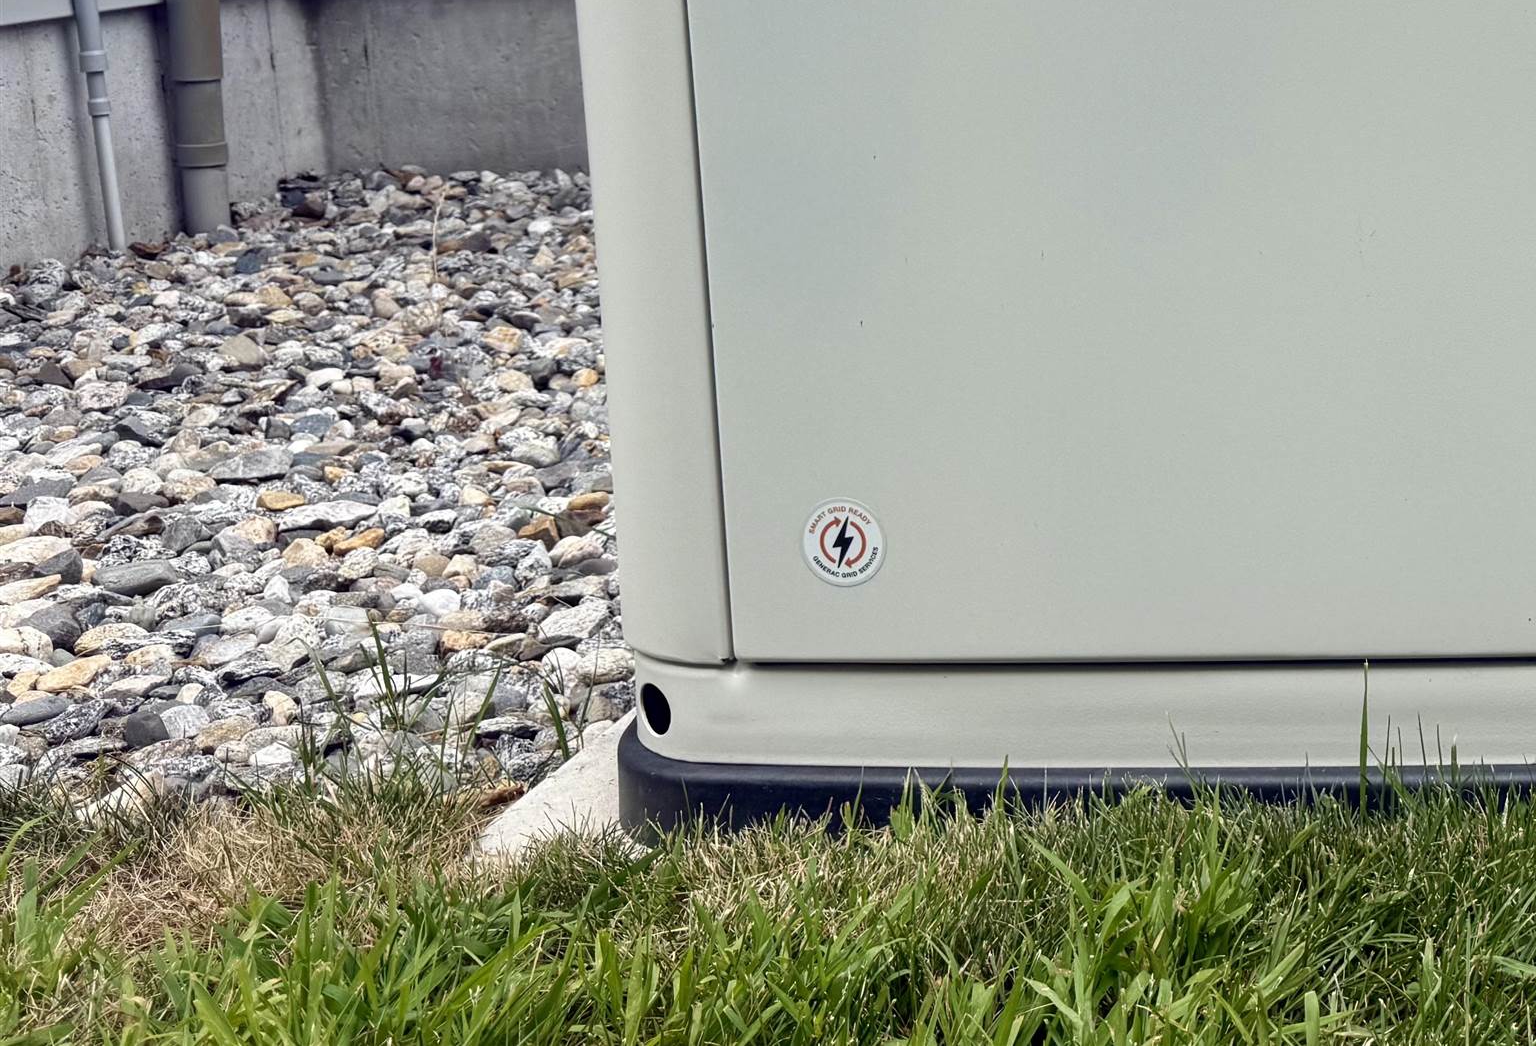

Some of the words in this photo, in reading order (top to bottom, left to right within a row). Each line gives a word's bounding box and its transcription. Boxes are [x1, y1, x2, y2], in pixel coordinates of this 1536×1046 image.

[808, 511, 826, 535] SMART
[827, 505, 847, 514] GRID
[848, 507, 872, 525] READY
[812, 555, 840, 578] GENERAC
[841, 570, 858, 579] GRID
[858, 546, 879, 574] SERVICES
